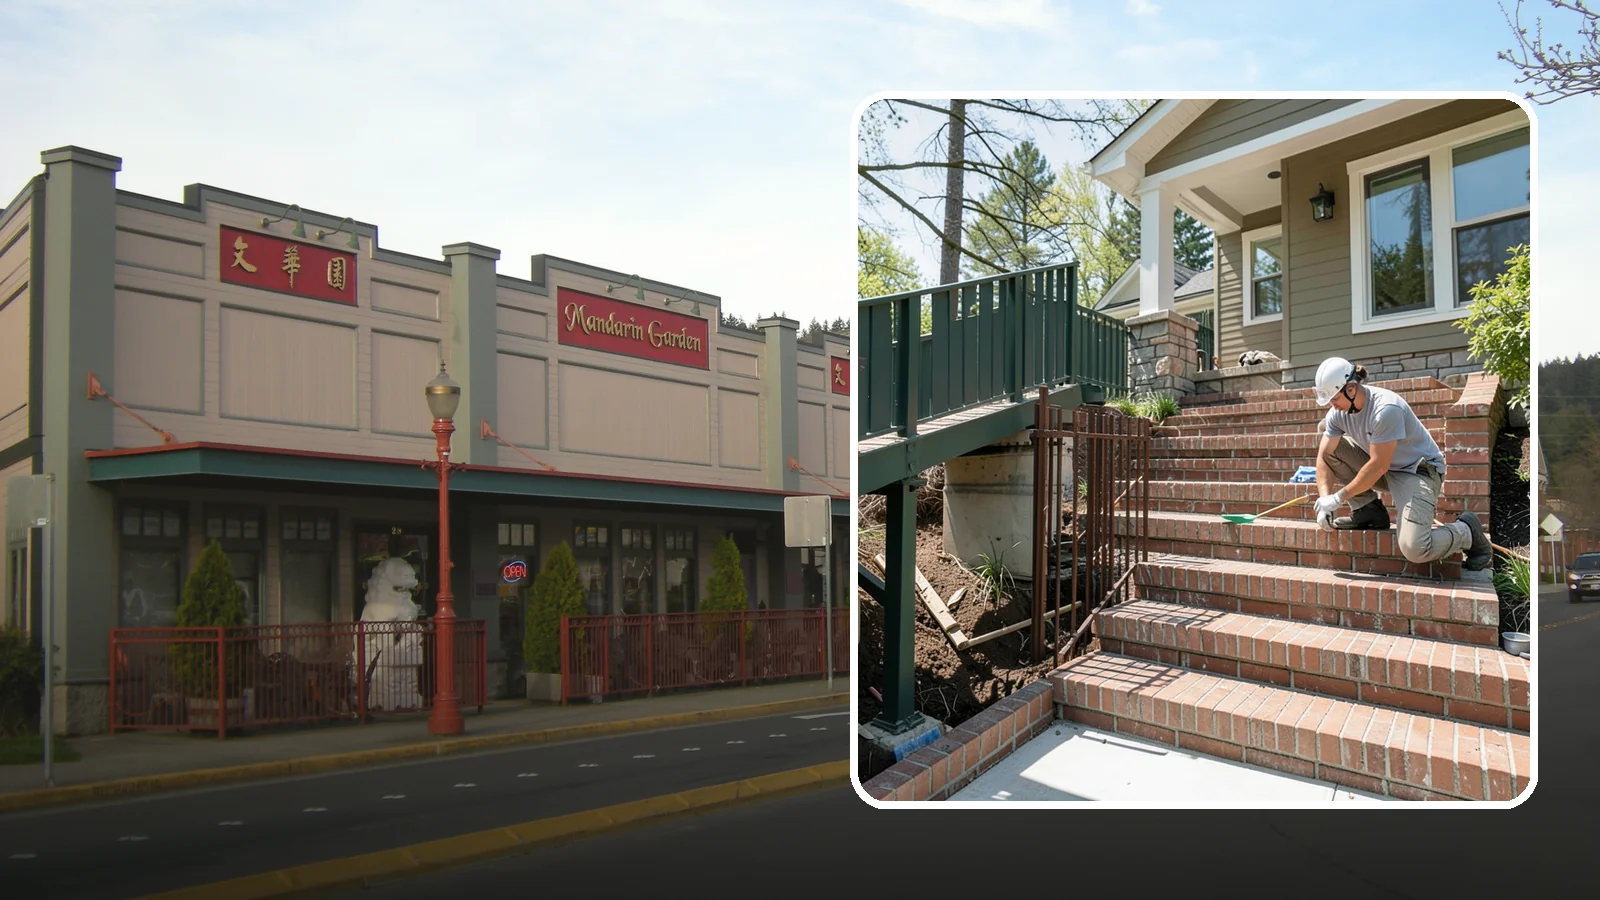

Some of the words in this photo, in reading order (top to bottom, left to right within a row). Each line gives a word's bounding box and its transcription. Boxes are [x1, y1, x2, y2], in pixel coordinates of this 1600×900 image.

[564, 302, 644, 342] Mandarin
[648, 319, 702, 352] Garden
[503, 565, 527, 578] OPEN
